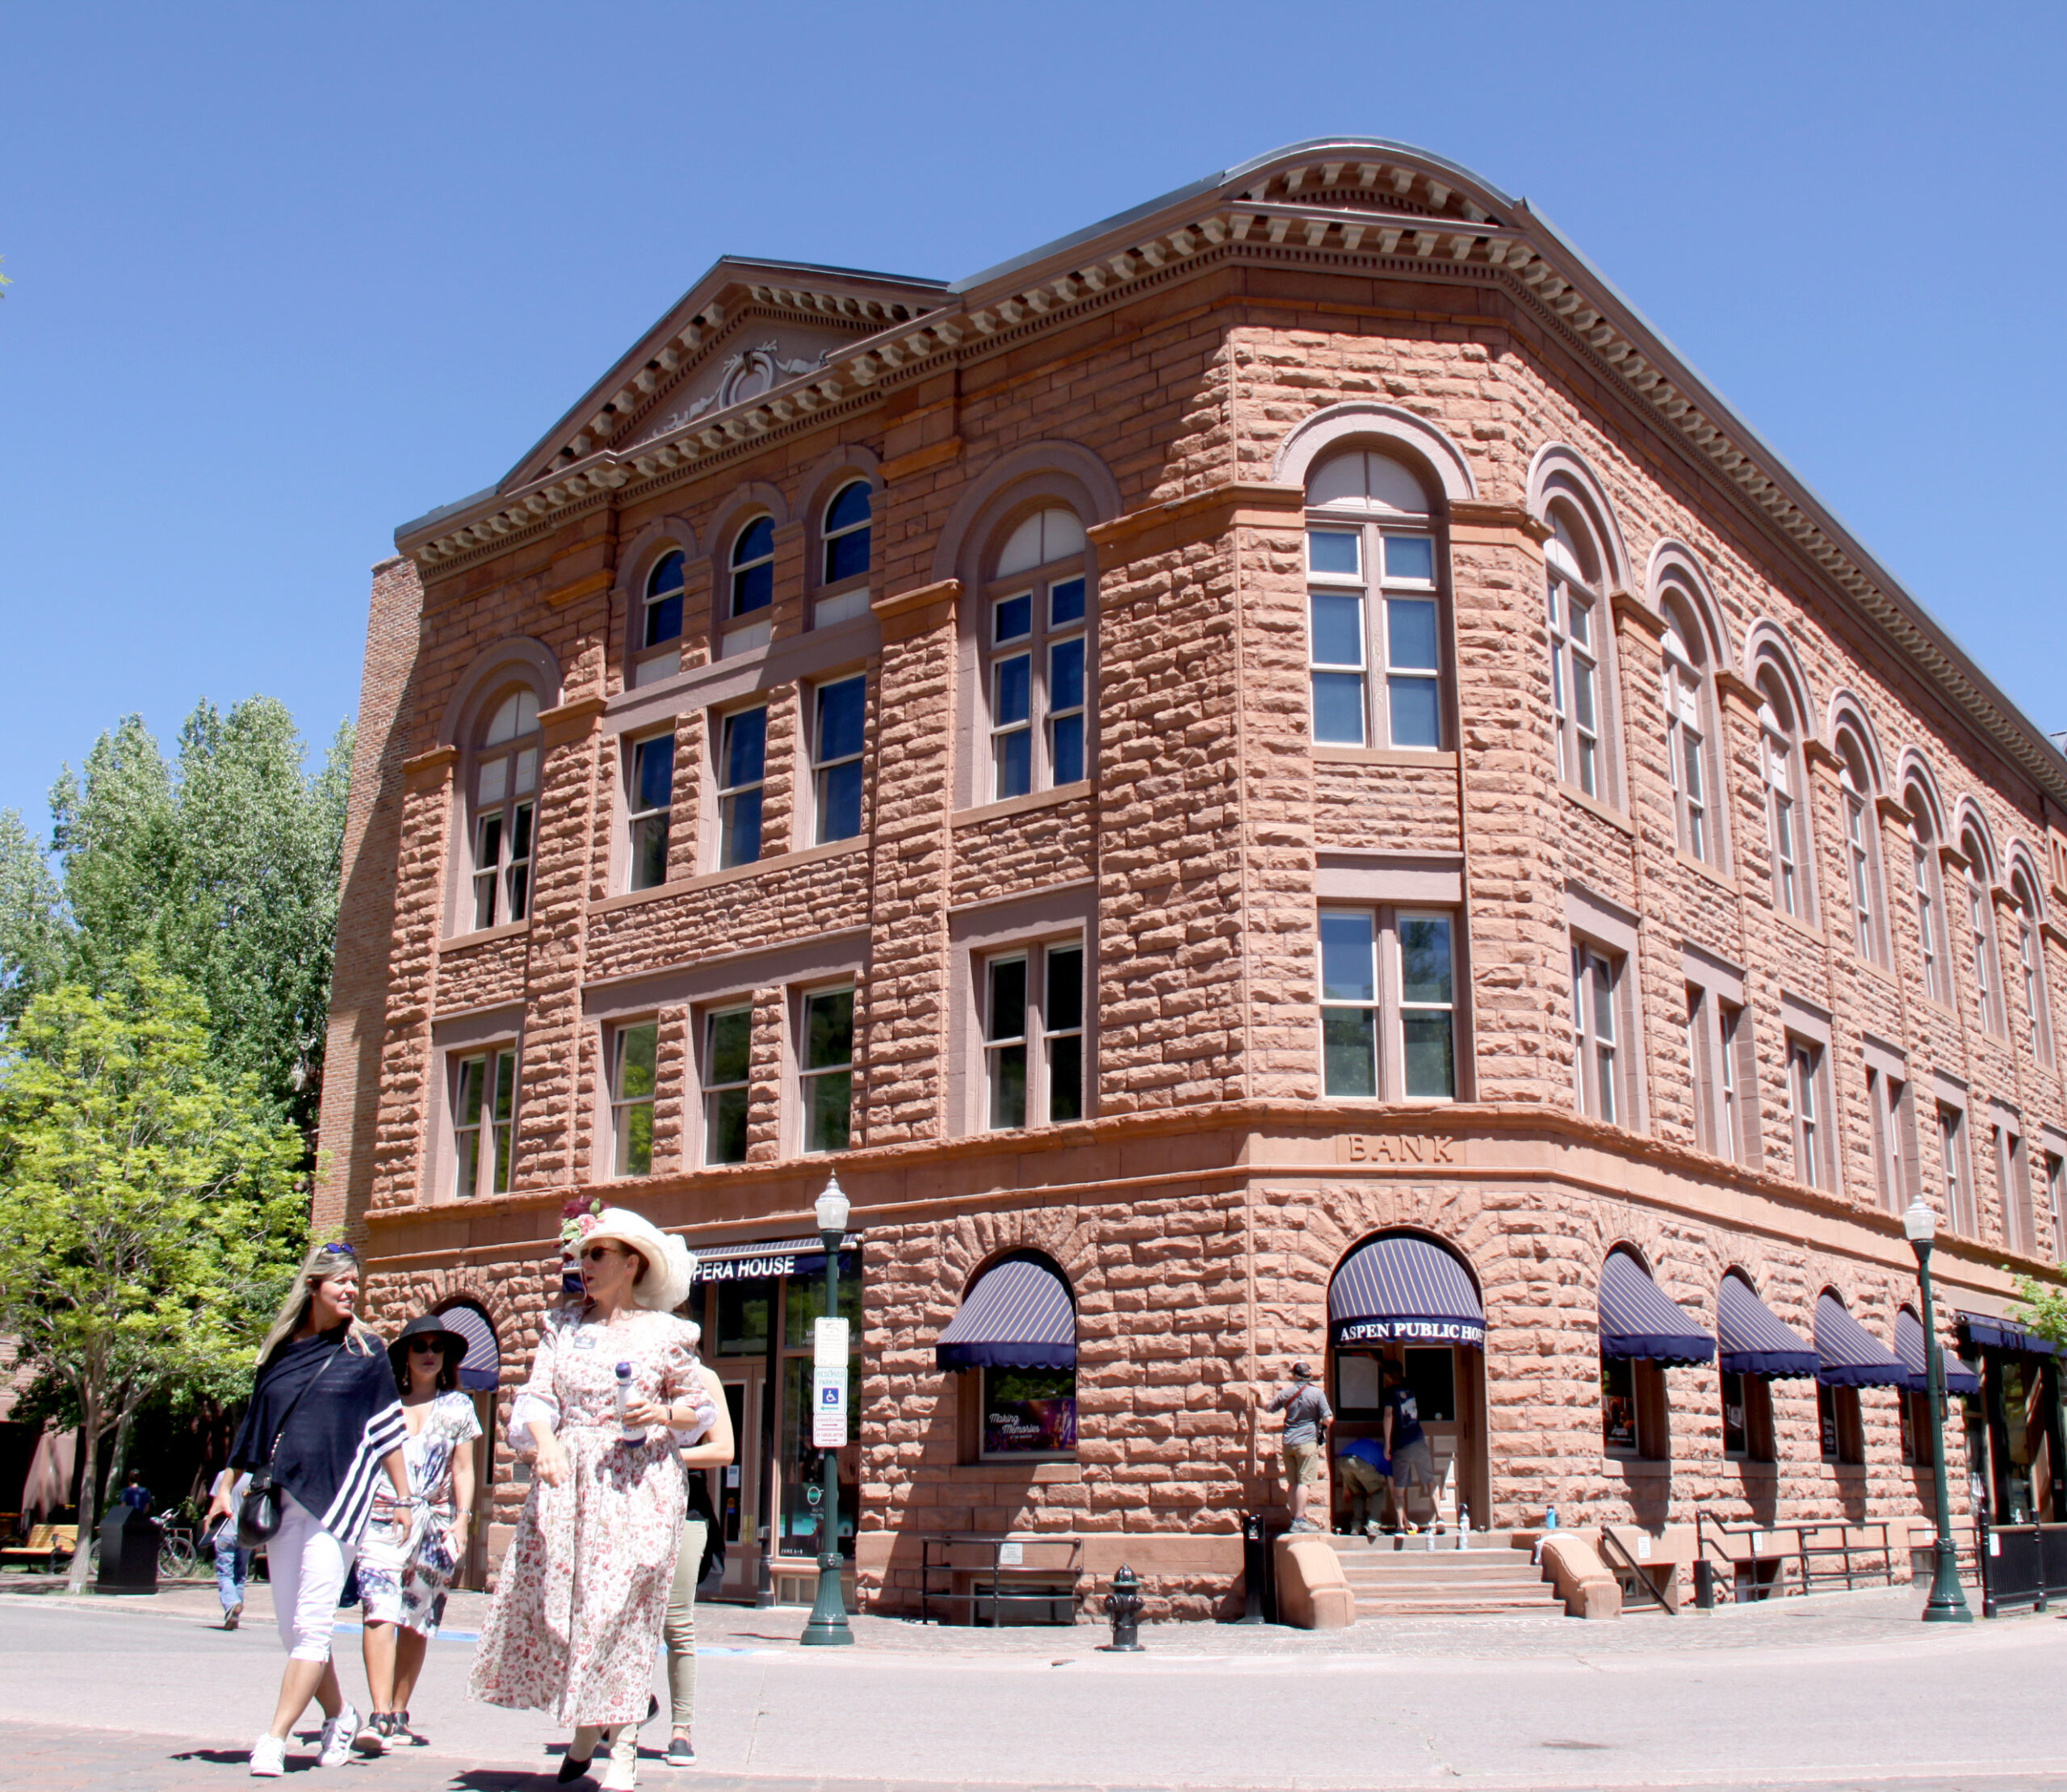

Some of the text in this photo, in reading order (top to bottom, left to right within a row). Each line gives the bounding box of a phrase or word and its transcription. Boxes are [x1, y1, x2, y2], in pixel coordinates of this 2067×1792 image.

[1348, 1134, 1453, 1163] BANK
[693, 1255, 795, 1282] PERA HOUSE
[1340, 1323, 1390, 1341] ASPEN
[1394, 1322, 1460, 1338] PUBLIC
[989, 1413, 1019, 1425] Making
[1002, 1424, 1040, 1434] Memories
